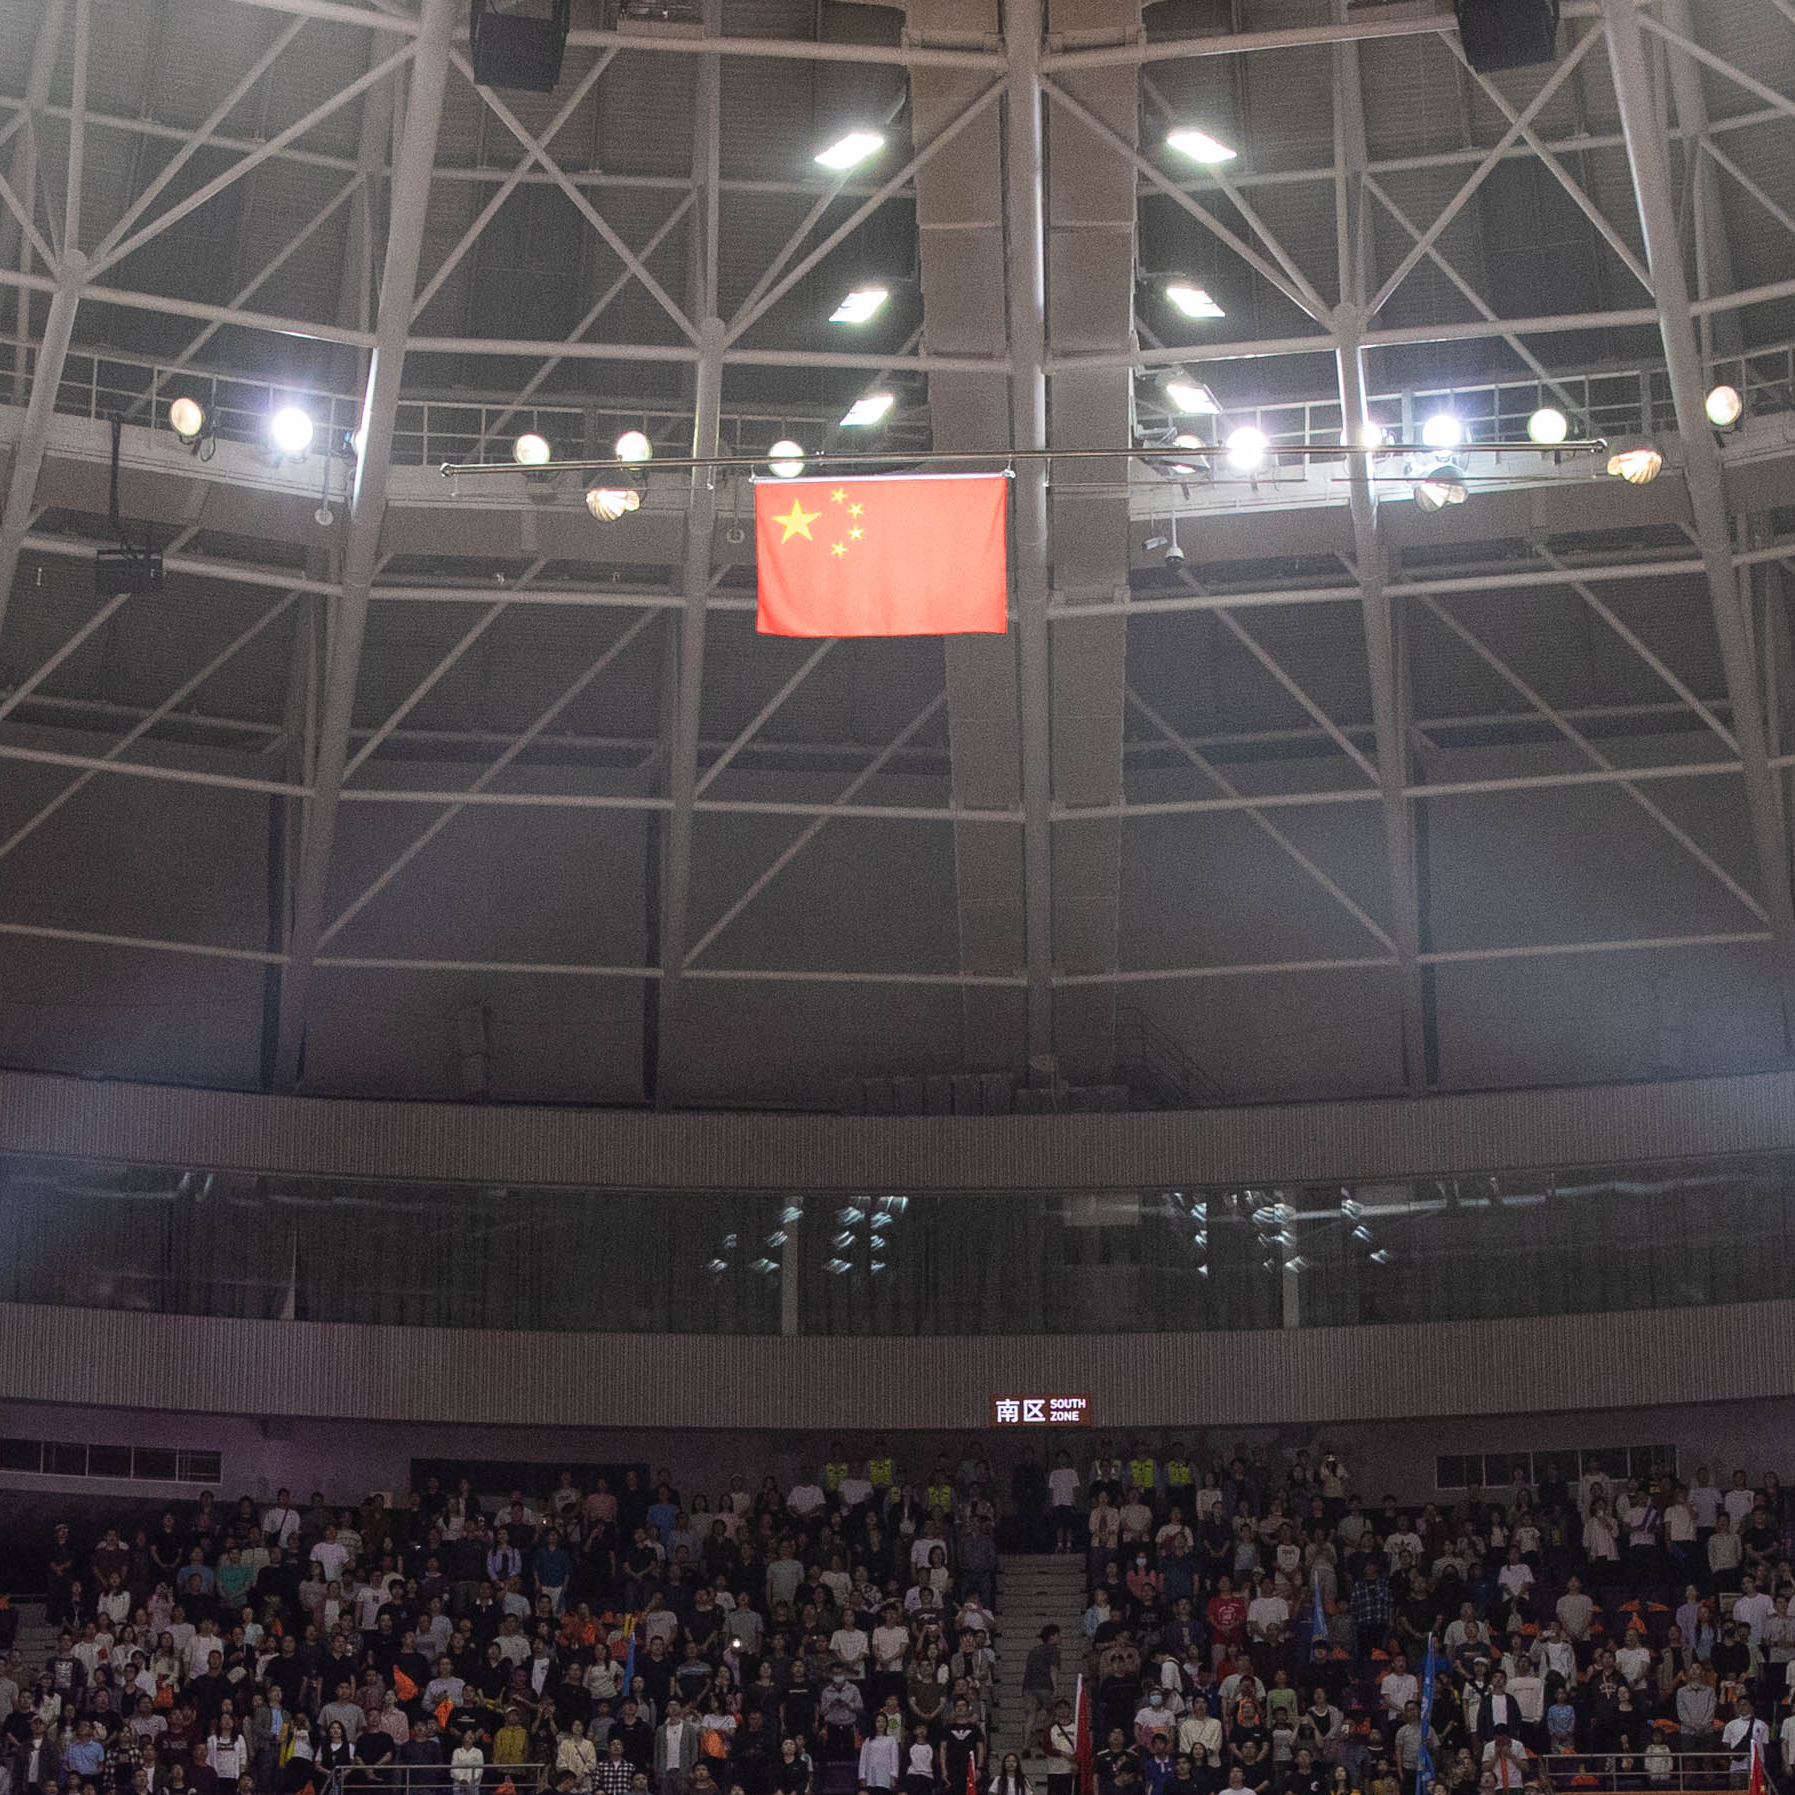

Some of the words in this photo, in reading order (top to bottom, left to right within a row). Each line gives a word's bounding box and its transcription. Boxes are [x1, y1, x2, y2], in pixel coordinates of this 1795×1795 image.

[1050, 1399, 1086, 1409] SOUTH
[996, 1399, 1045, 1422] 南区
[1050, 1411, 1080, 1421] ZONE
